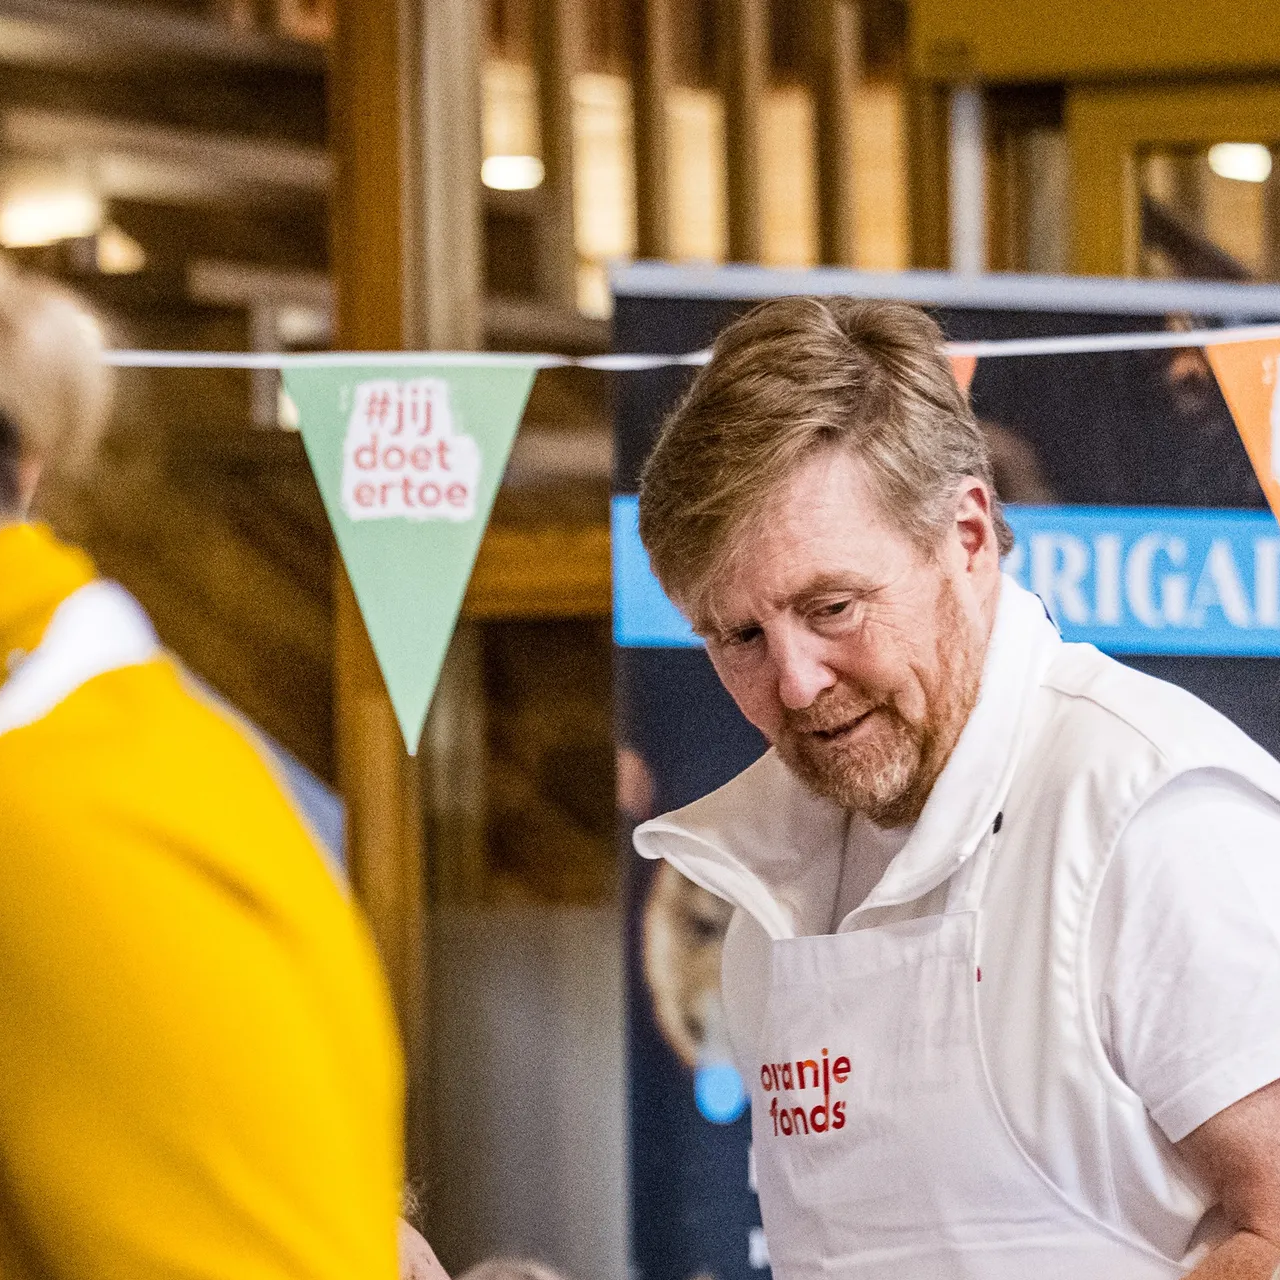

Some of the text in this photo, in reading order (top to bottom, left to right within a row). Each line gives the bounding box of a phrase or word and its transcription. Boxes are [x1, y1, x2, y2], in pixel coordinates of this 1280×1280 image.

[365, 384, 434, 437] #jij
[353, 433, 452, 471] doet
[353, 476, 469, 508] ertoe
[760, 1047, 852, 1097] oranje
[770, 1096, 847, 1137] fonds
